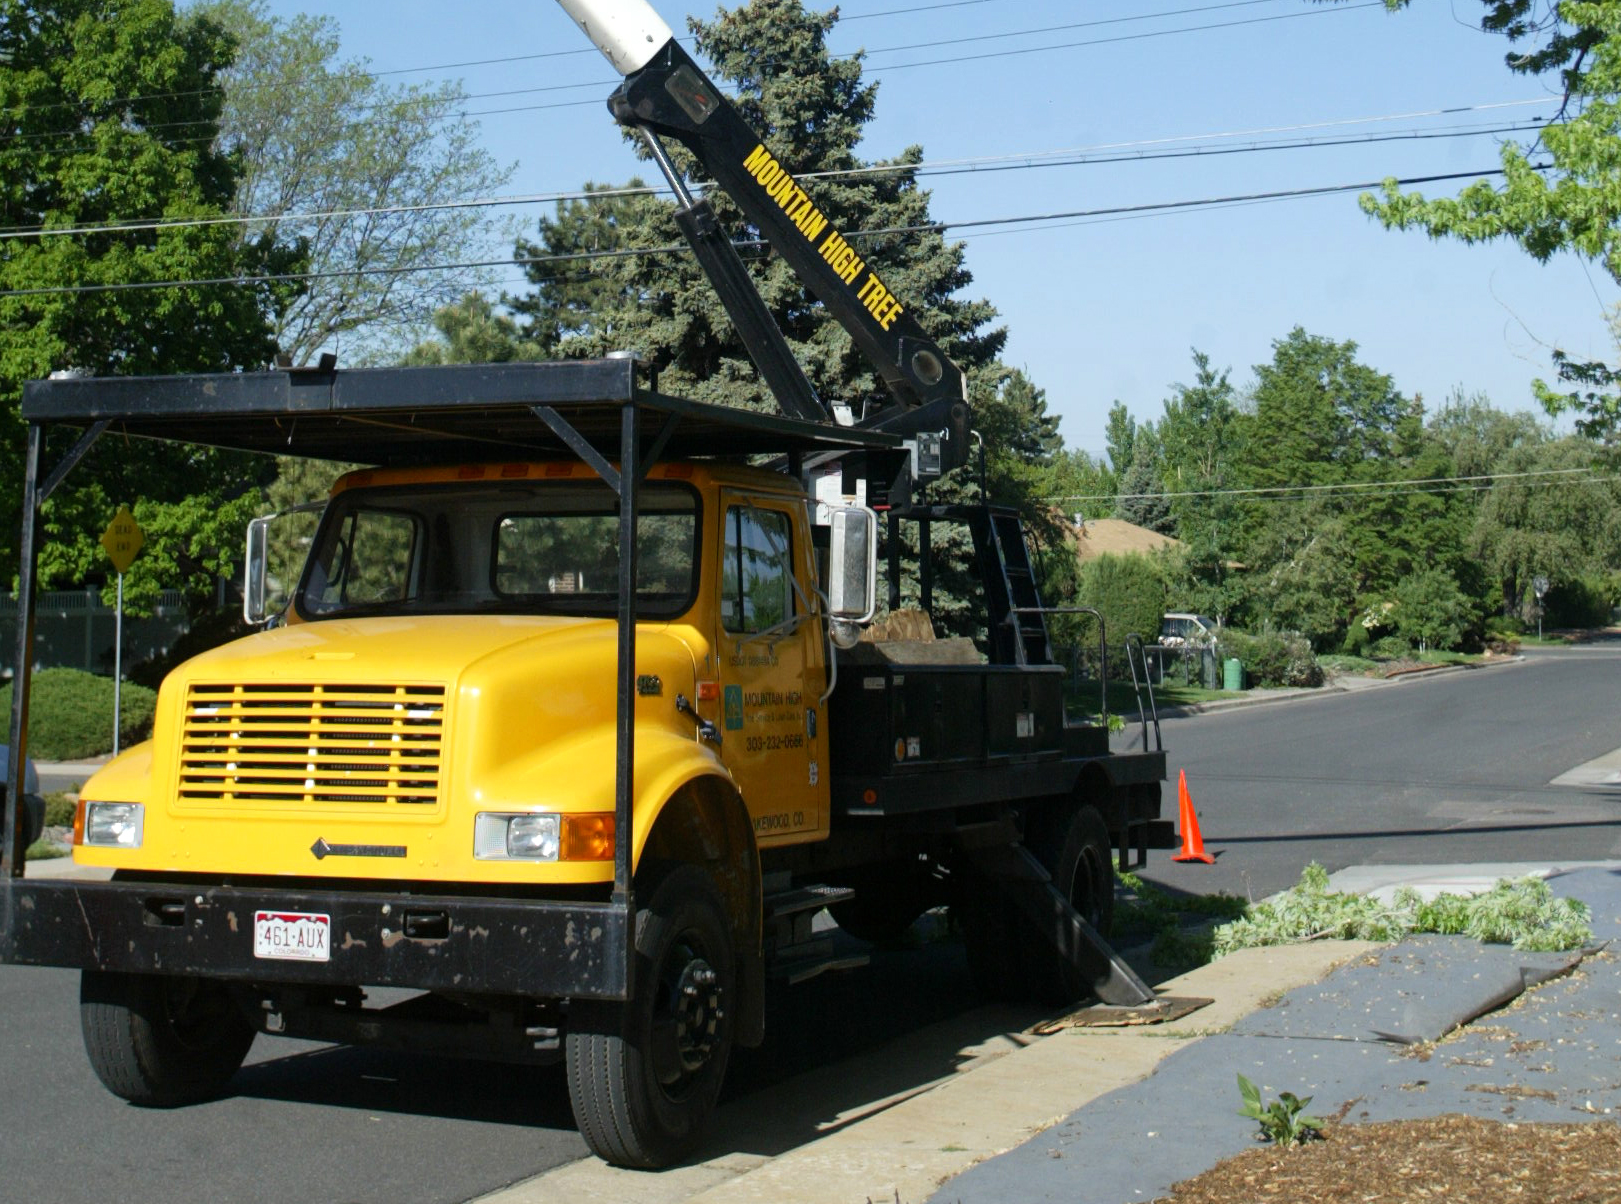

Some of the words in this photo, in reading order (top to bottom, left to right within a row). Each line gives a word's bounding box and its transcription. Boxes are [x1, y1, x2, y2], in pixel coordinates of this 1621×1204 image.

[743, 144, 828, 242] MOUNTAIN
[818, 231, 865, 285] HIGH
[857, 273, 903, 331] TREE
[745, 692, 783, 706] MOUNTAIN
[785, 691, 802, 705] HIGH
